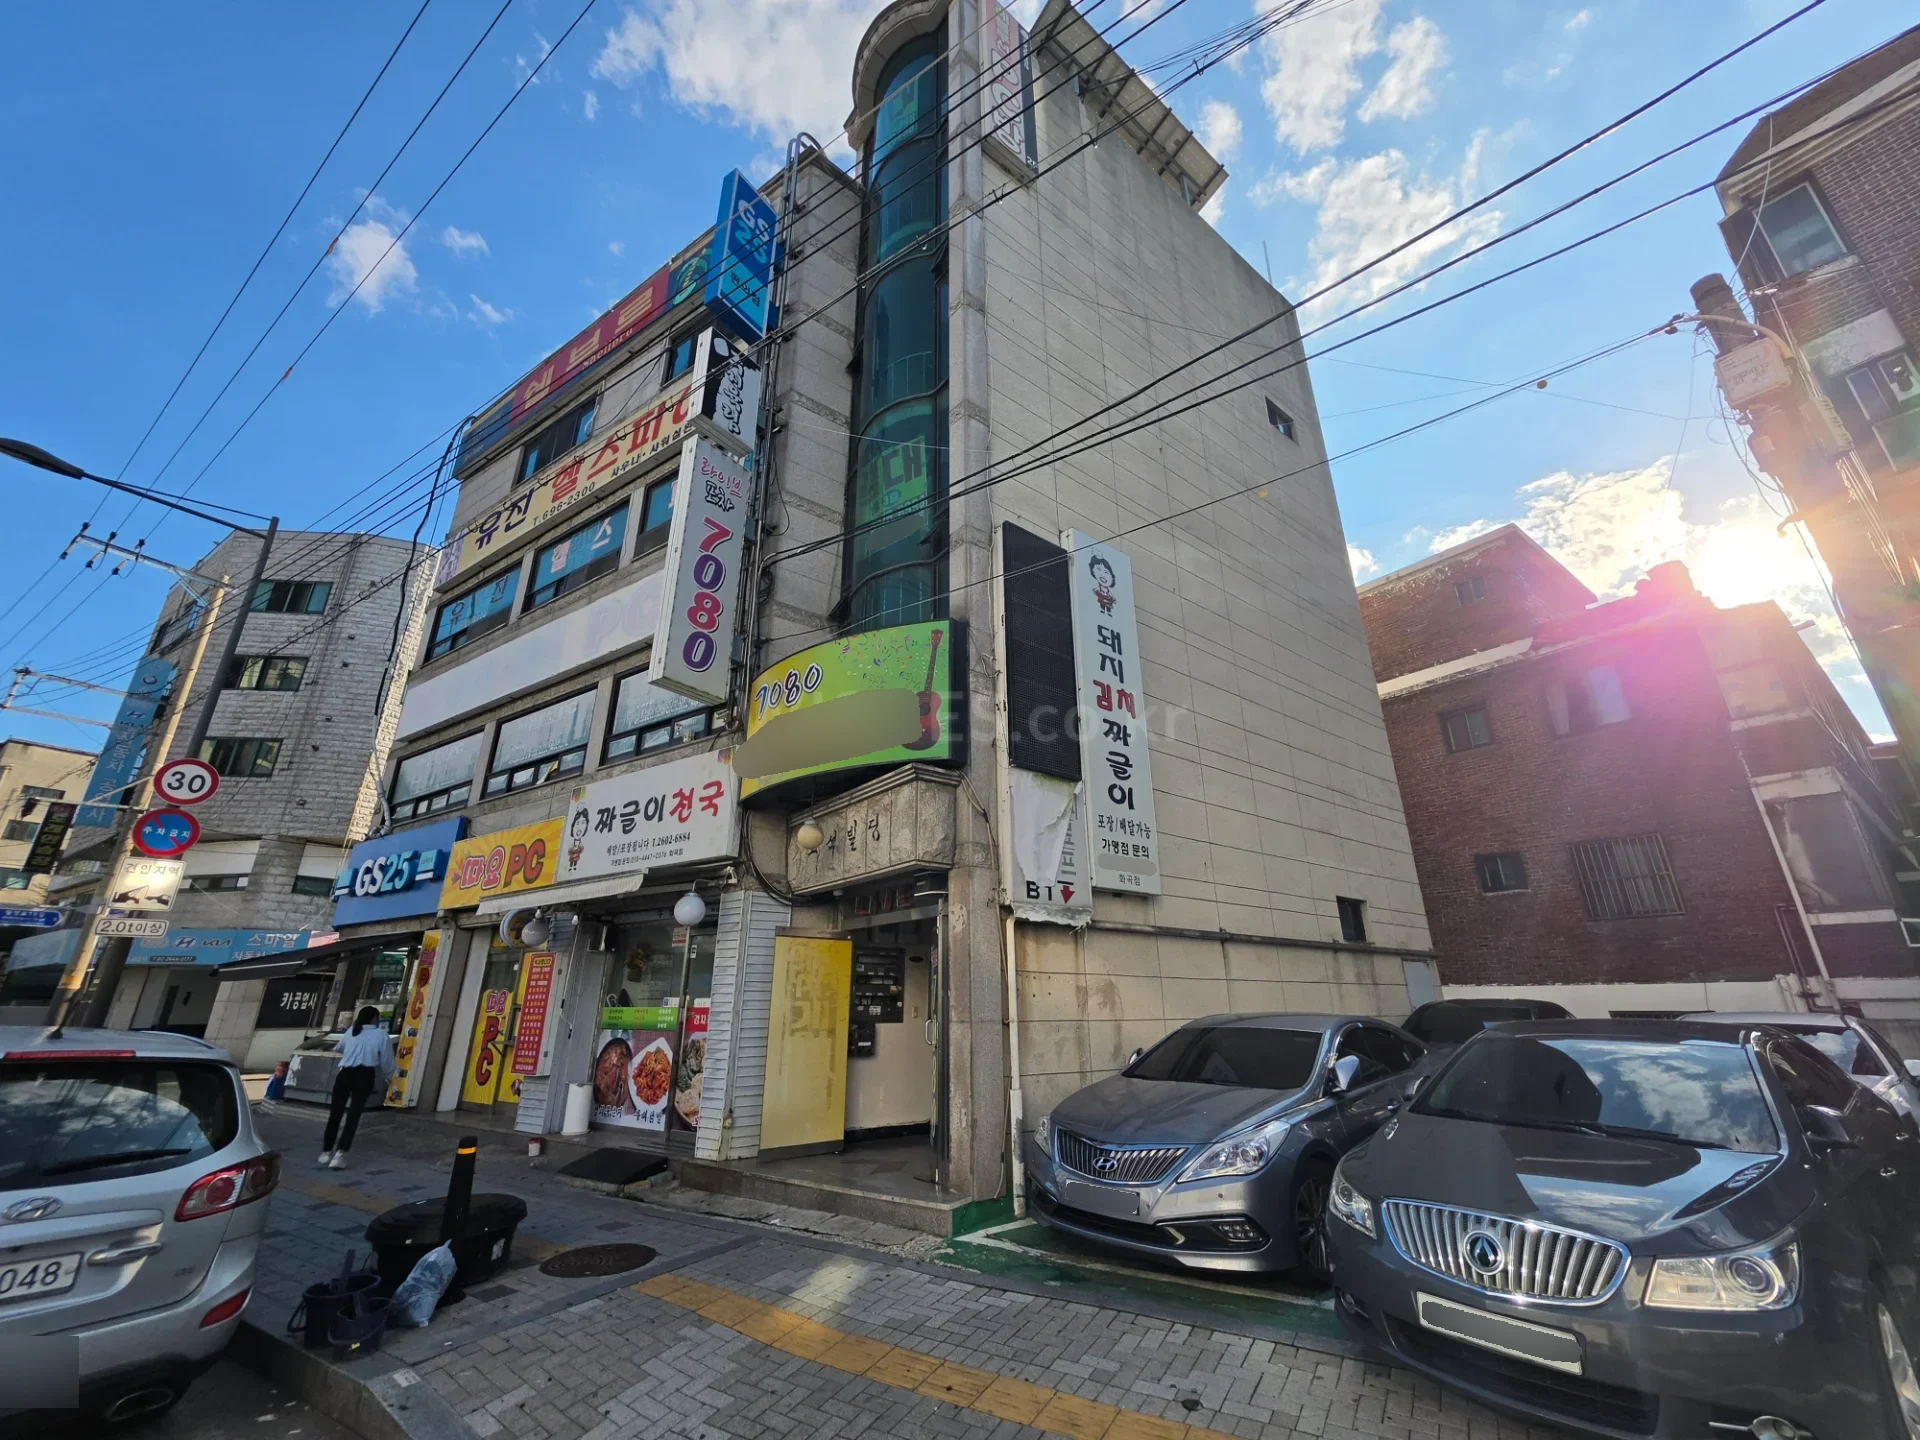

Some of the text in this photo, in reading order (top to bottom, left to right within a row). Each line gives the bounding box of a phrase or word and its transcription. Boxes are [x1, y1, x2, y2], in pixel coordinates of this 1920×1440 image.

[738, 200, 770, 241] GS
[735, 219, 767, 264] 25
[700, 457, 742, 498] 라이브
[706, 480, 735, 512] 포차
[475, 487, 535, 550] 유진
[532, 481, 596, 526] T.696-2300
[682, 515, 733, 672] 7080
[754, 663, 823, 721] 7080
[167, 771, 206, 794] 30
[143, 826, 191, 838] 주차금지
[1098, 814, 1151, 839] 포장/배달가능
[503, 838, 546, 888] PC
[1102, 838, 1150, 859] 가맹점 문의
[125, 863, 181, 876] 견인지역
[355, 850, 416, 897] GS25
[1119, 873, 1141, 887] 화곡점
[1026, 880, 1053, 901] B1
[246, 933, 300, 949] 스마일
[411, 967, 430, 1019] PC
[475, 1016, 500, 1086] PC
[0, 1261, 61, 1295] 048
